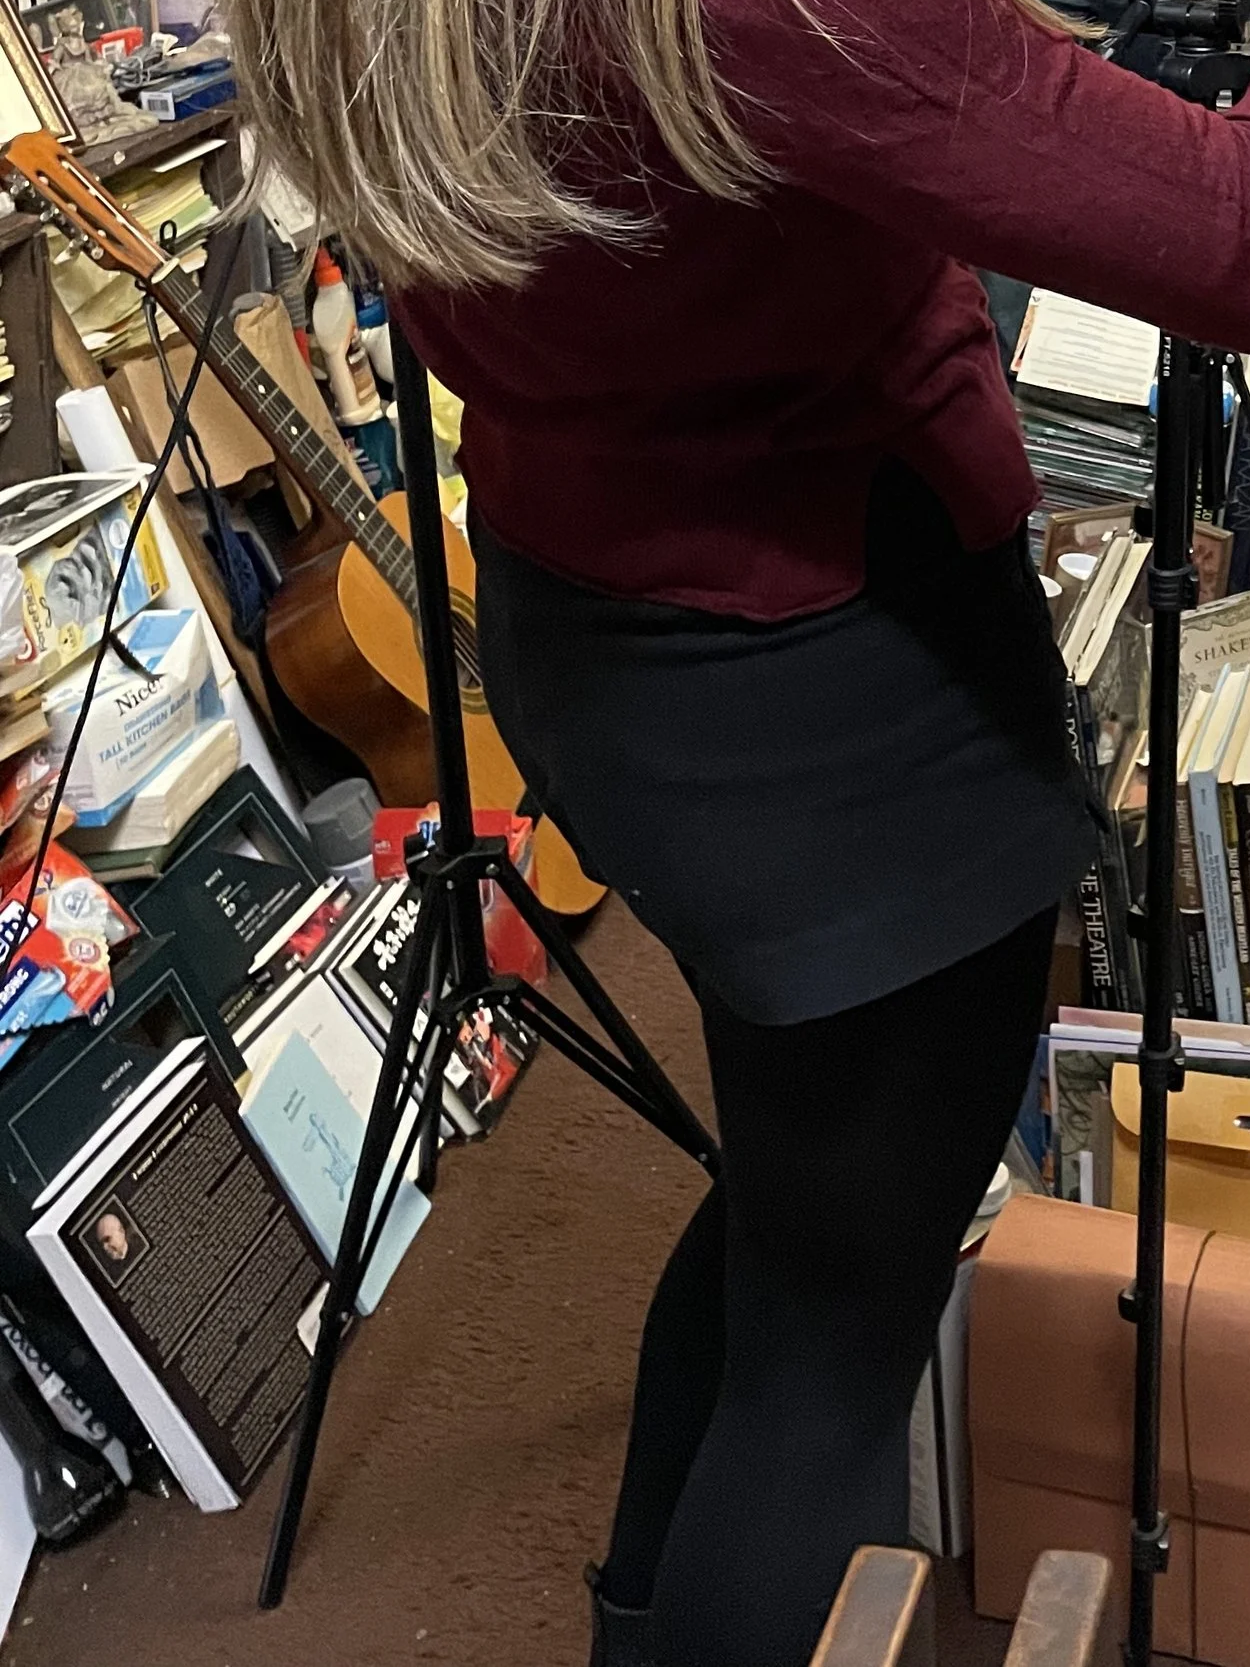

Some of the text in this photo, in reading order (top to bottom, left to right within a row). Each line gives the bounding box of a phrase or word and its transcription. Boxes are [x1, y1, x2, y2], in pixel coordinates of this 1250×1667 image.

[99, 714, 169, 762] TALL KITCHEN
[1080, 897, 1111, 987] THEATRE
